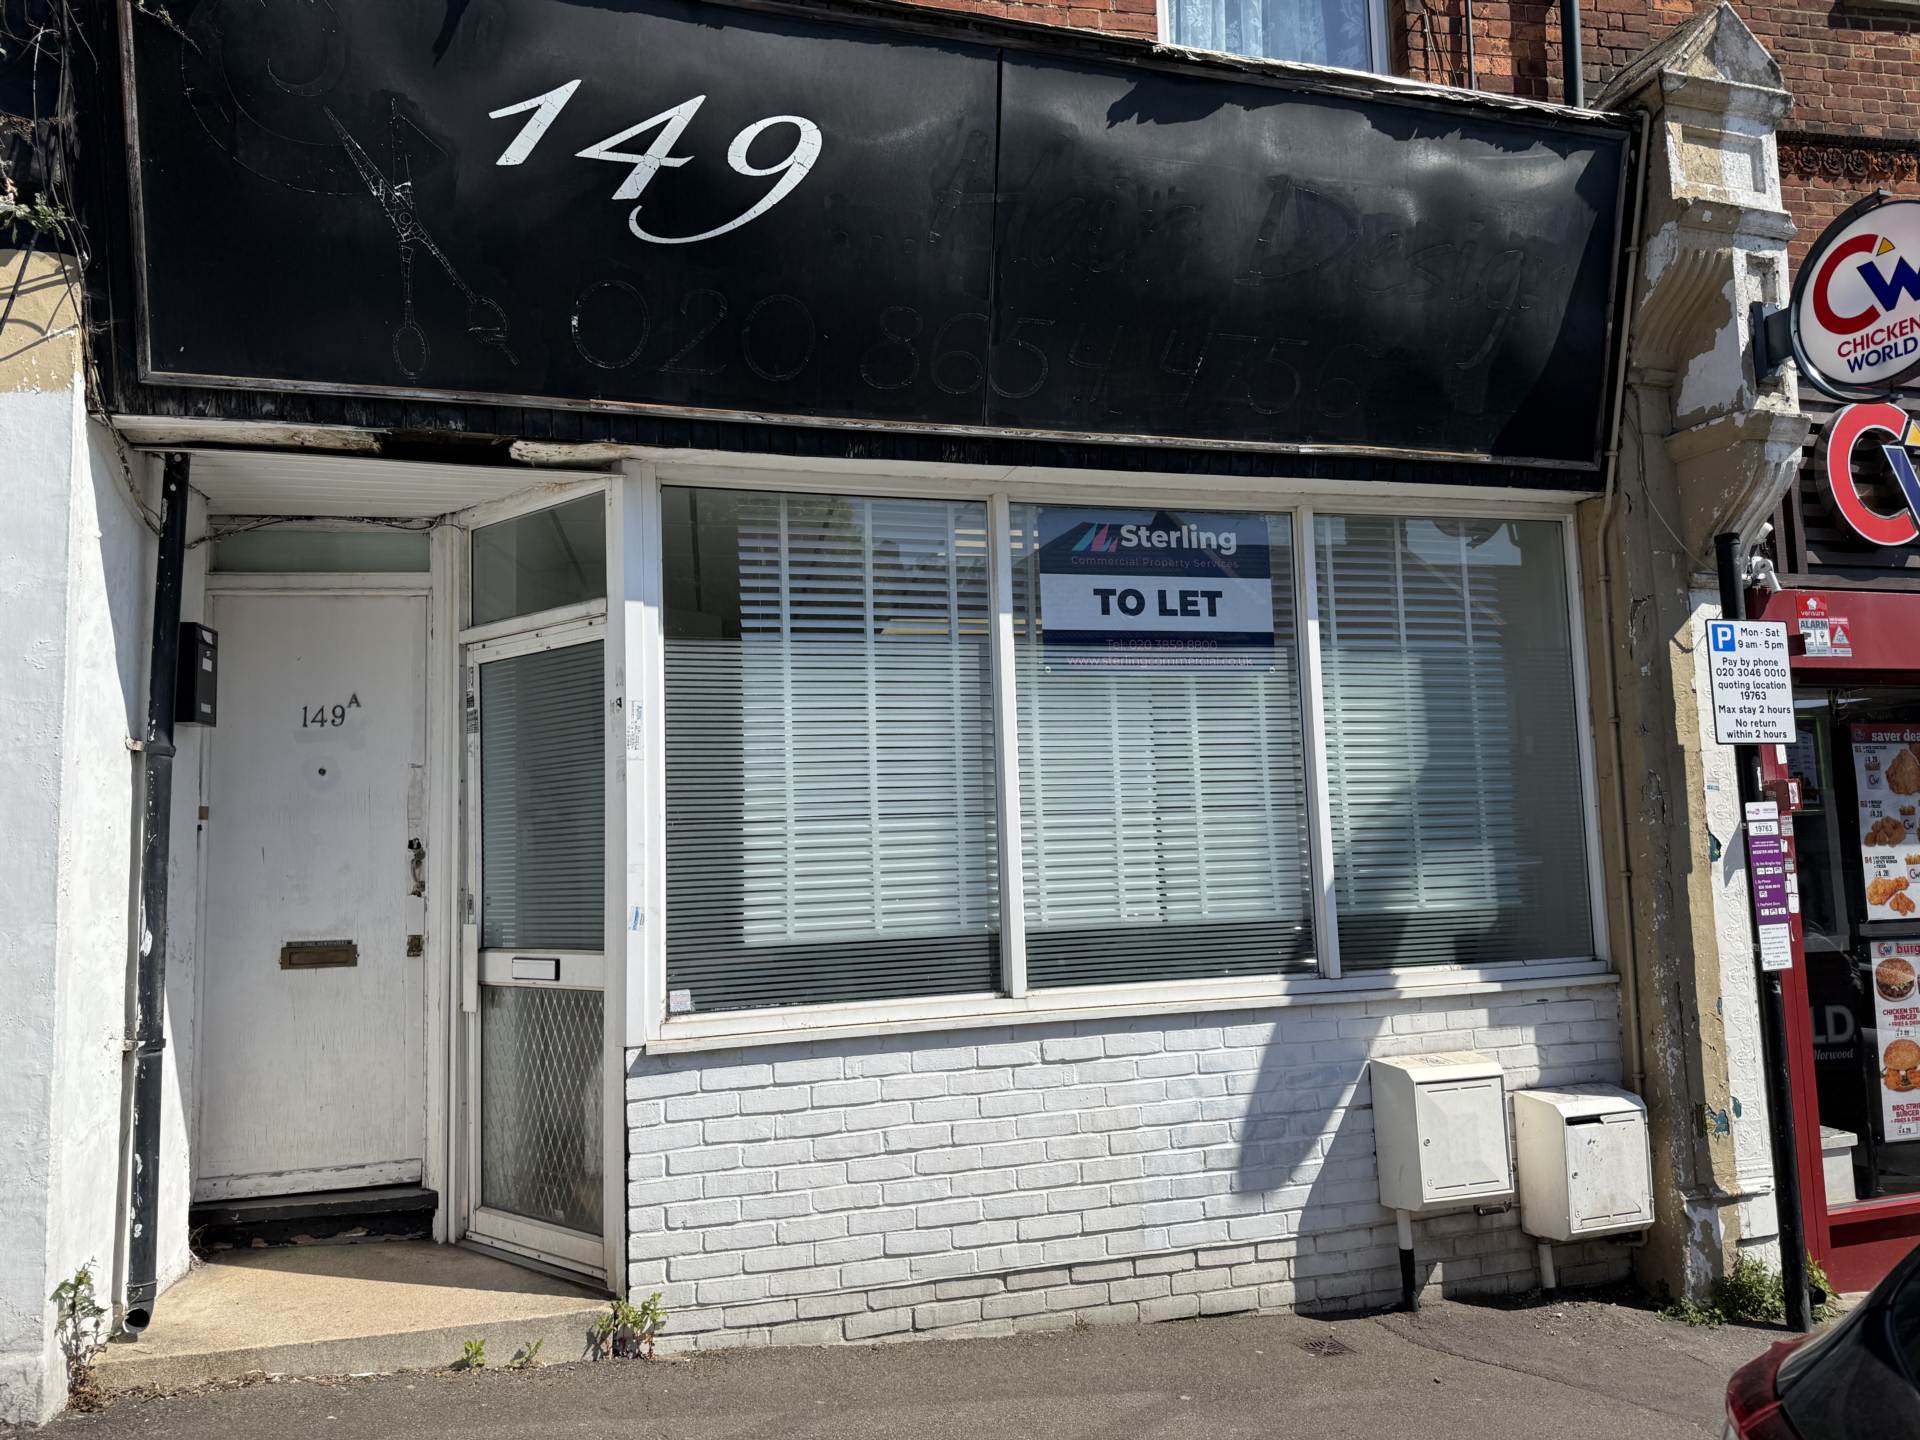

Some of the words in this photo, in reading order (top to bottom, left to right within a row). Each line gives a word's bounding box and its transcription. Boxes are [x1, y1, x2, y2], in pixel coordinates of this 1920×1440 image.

[487, 79, 824, 245] 149
[1837, 314, 1920, 358] CHICKEN
[1846, 336, 1919, 373] WORLD
[1120, 523, 1237, 555] Sterling
[1071, 556, 1139, 567] Commercial
[1142, 557, 1191, 569] Property
[1193, 558, 1240, 569] Services
[1093, 588, 1146, 617] TO
[1157, 589, 1223, 617] LET
[1800, 620, 1828, 629] ALARM
[1740, 628, 1759, 637] Mon
[1765, 628, 1780, 637] Sat
[1717, 627, 1732, 649] P
[1128, 639, 1152, 650] 020
[1737, 640, 1744, 649] 9
[1764, 640, 1770, 649] 5
[1771, 642, 1785, 650] pm
[1722, 657, 1738, 667] Pay
[1740, 657, 1750, 667] by
[1753, 658, 1779, 668] phone
[1715, 668, 1734, 677] 020
[1737, 668, 1761, 677] 3046
[1763, 668, 1787, 677] 0010
[1718, 680, 1751, 690] quoting
[1753, 680, 1787, 690] location
[1740, 691, 1767, 701] 19763
[1718, 704, 1736, 714] Max
[1739, 705, 1756, 715] stay
[1760, 705, 1765, 714] 2
[1767, 705, 1791, 714] hours
[1735, 719, 1748, 728] No
[1750, 719, 1777, 728] return
[1726, 730, 1753, 739] within
[1755, 730, 1761, 739] 2
[1763, 730, 1788, 739] hours
[1871, 732, 1900, 742] saver
[1754, 824, 1773, 833] 19763
[1882, 1007, 1908, 1016] CHICKEN
[1893, 1013, 1918, 1021] BURGER
[1892, 1104, 1905, 1112] BBQ
[1895, 1109, 1920, 1118] BURGER
